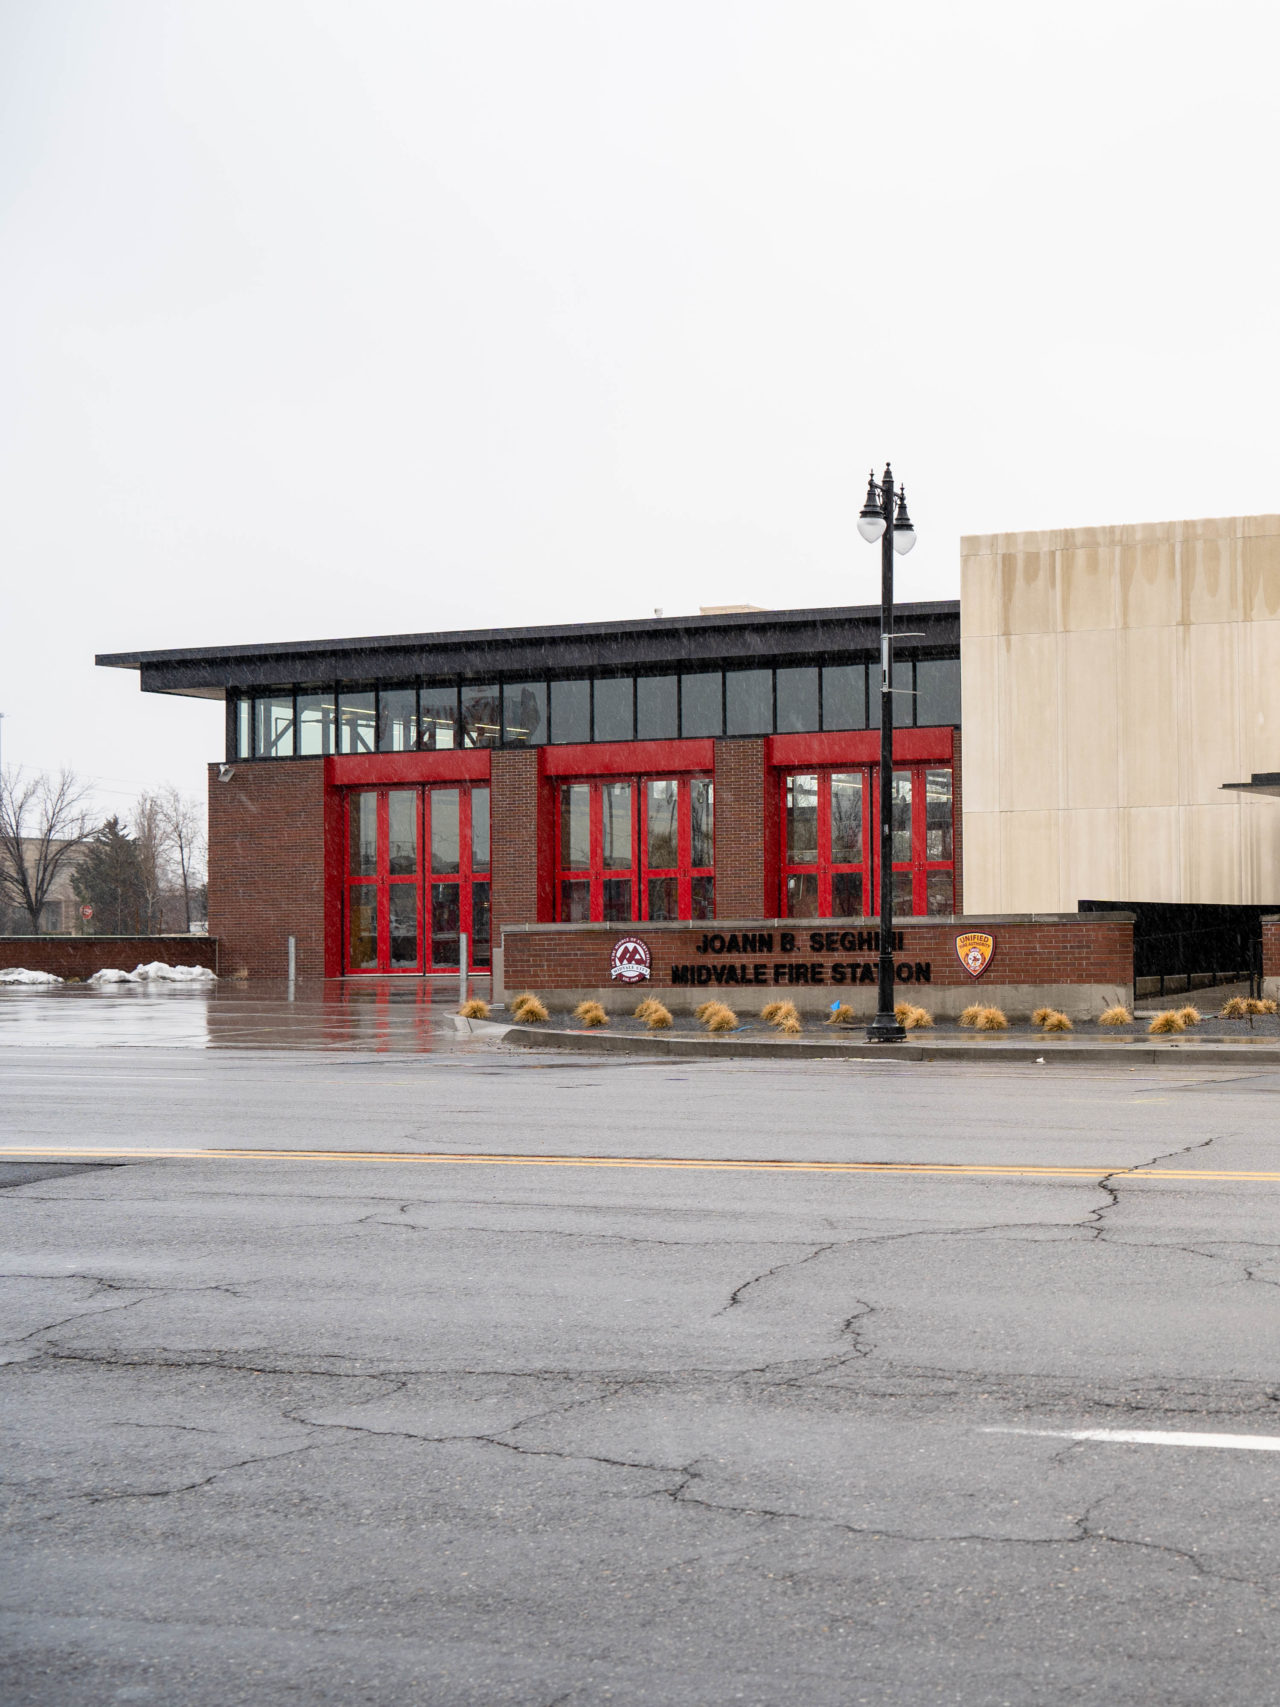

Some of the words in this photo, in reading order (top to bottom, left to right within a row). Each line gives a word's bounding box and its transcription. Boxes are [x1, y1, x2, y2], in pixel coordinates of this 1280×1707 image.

[696, 933, 773, 954] JOANN
[780, 932, 801, 953] B.
[959, 934, 989, 943] UNIFIED
[672, 965, 767, 984] MIDVALE
[773, 963, 824, 983] FIRE
